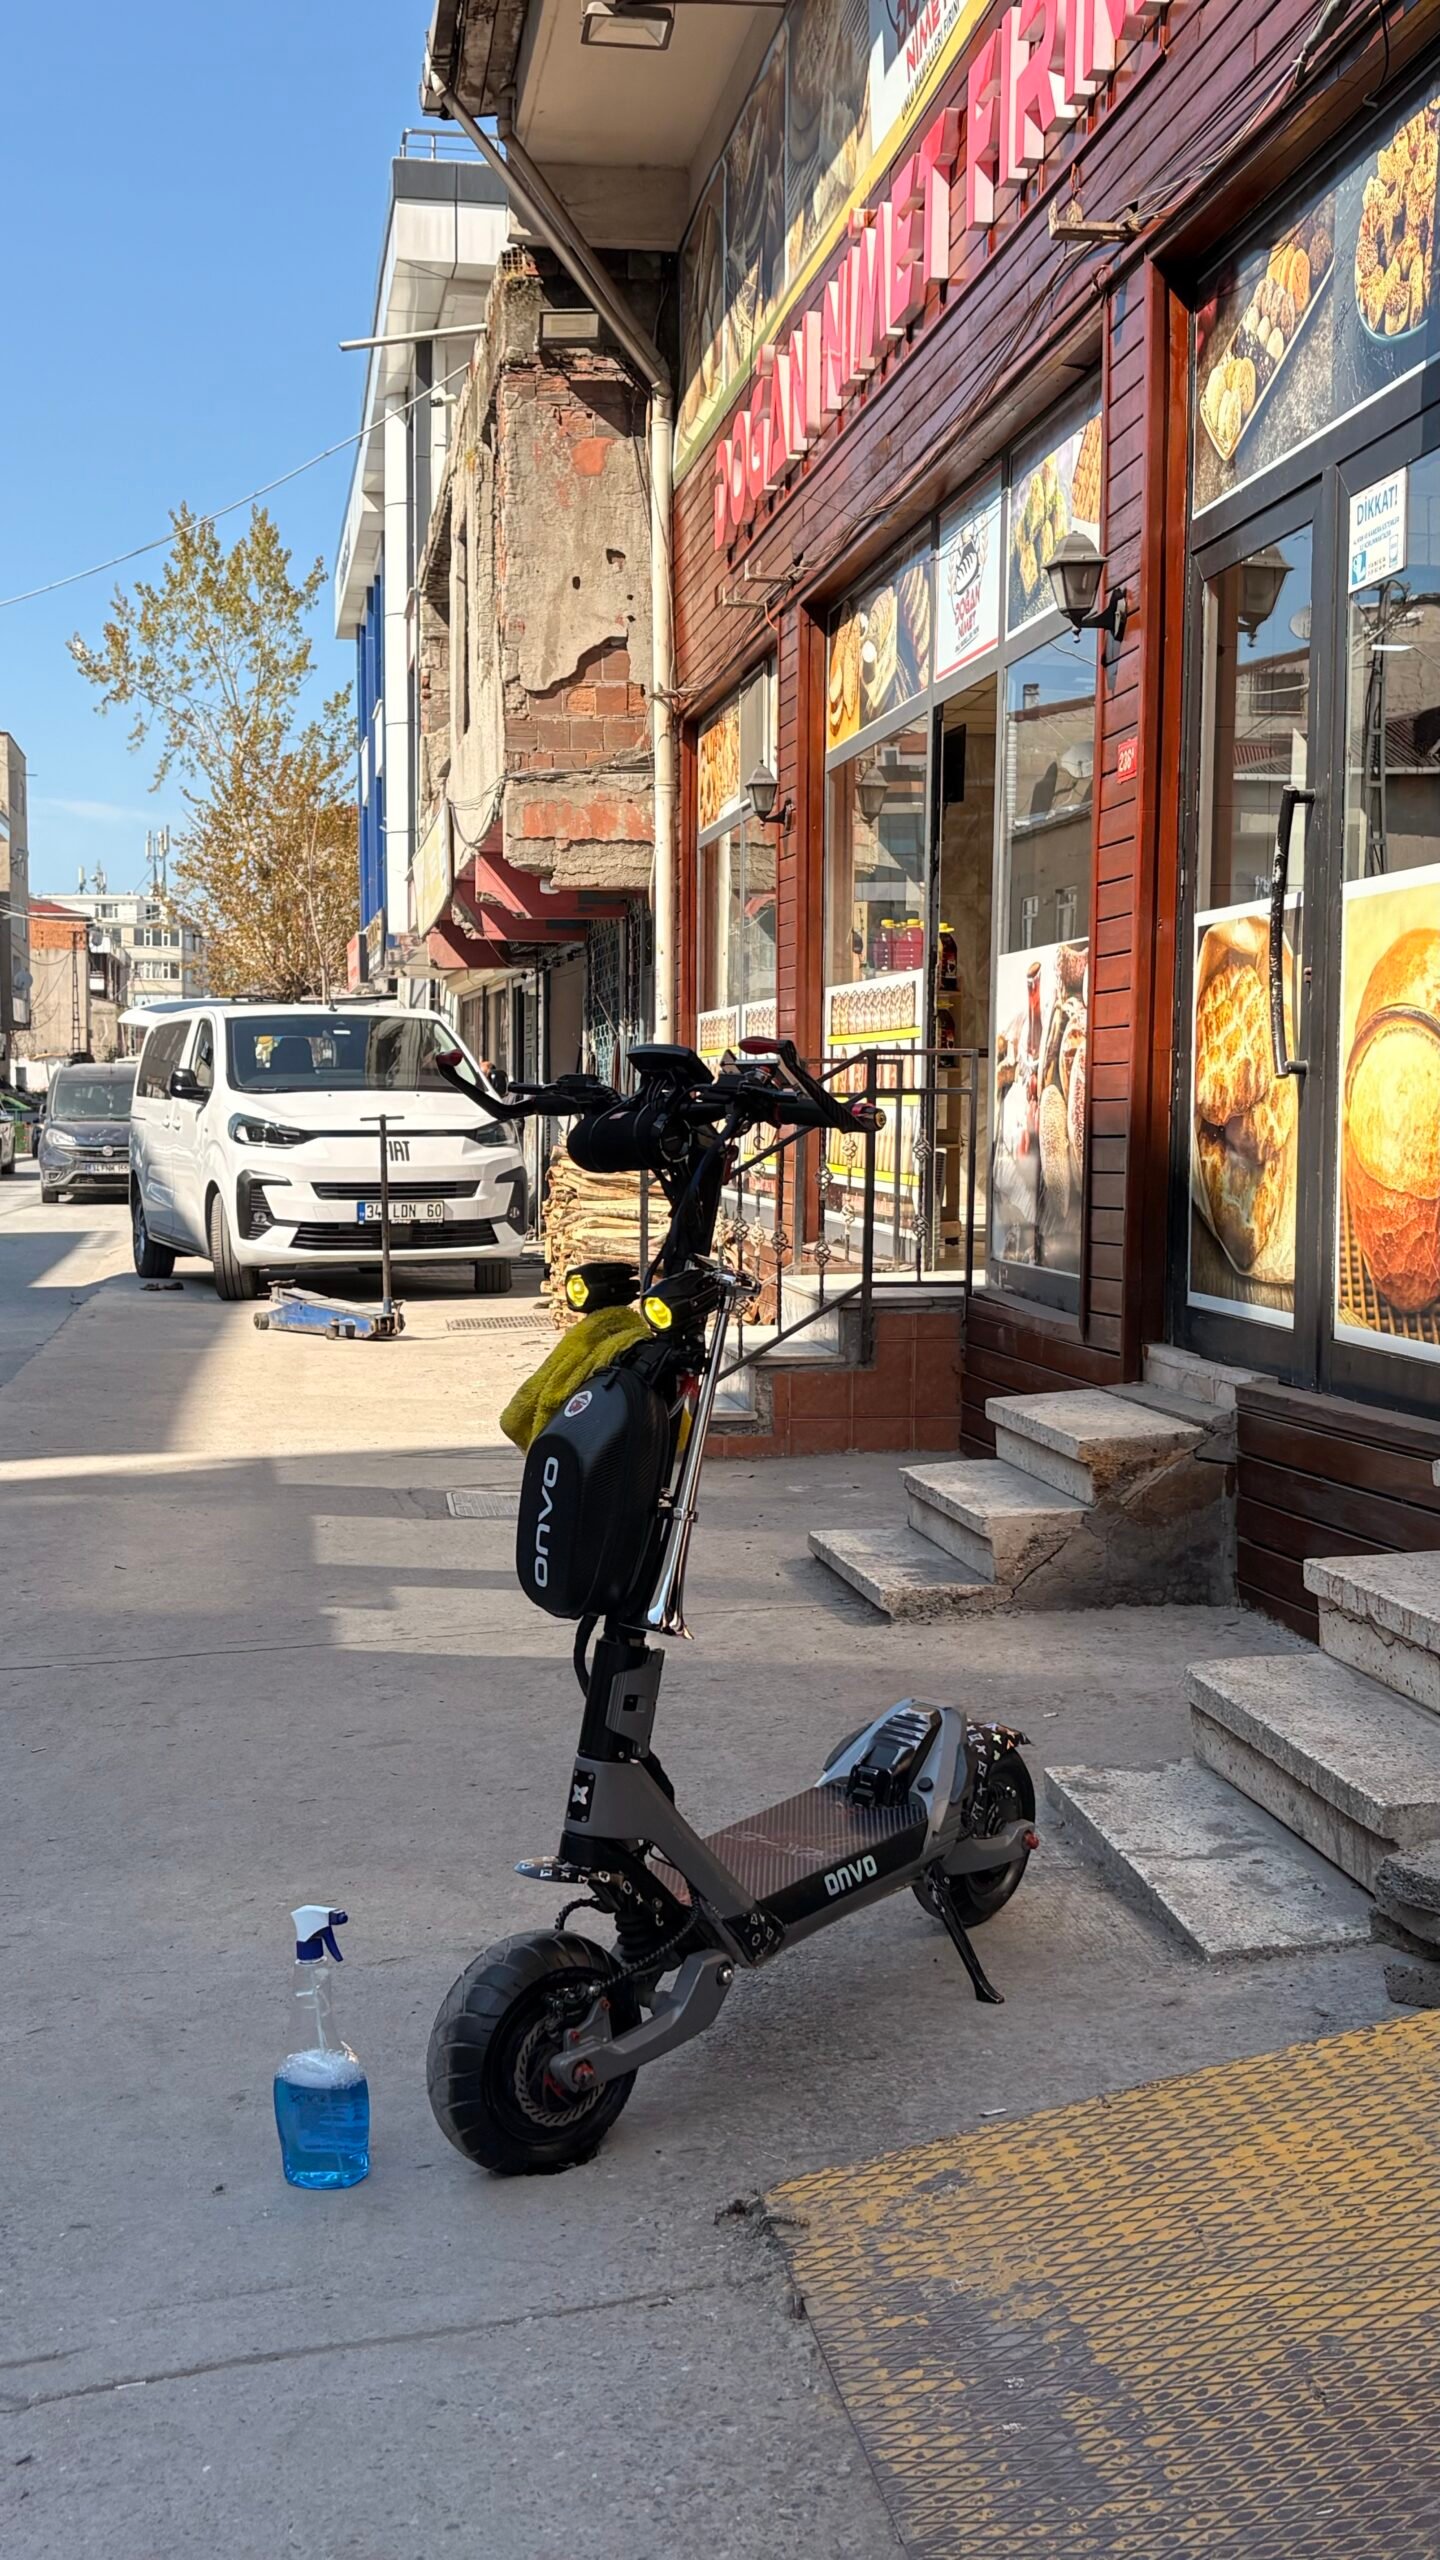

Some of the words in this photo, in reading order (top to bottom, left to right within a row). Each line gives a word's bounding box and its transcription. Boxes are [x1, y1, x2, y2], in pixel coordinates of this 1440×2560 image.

[822, 107, 963, 414] NİMET
[1356, 484, 1398, 526] DİKKAT!
[386, 1141, 410, 1161] IAT
[366, 1204, 382, 1218] 34
[393, 1204, 416, 1218] LDN
[427, 1203, 442, 1218] 60
